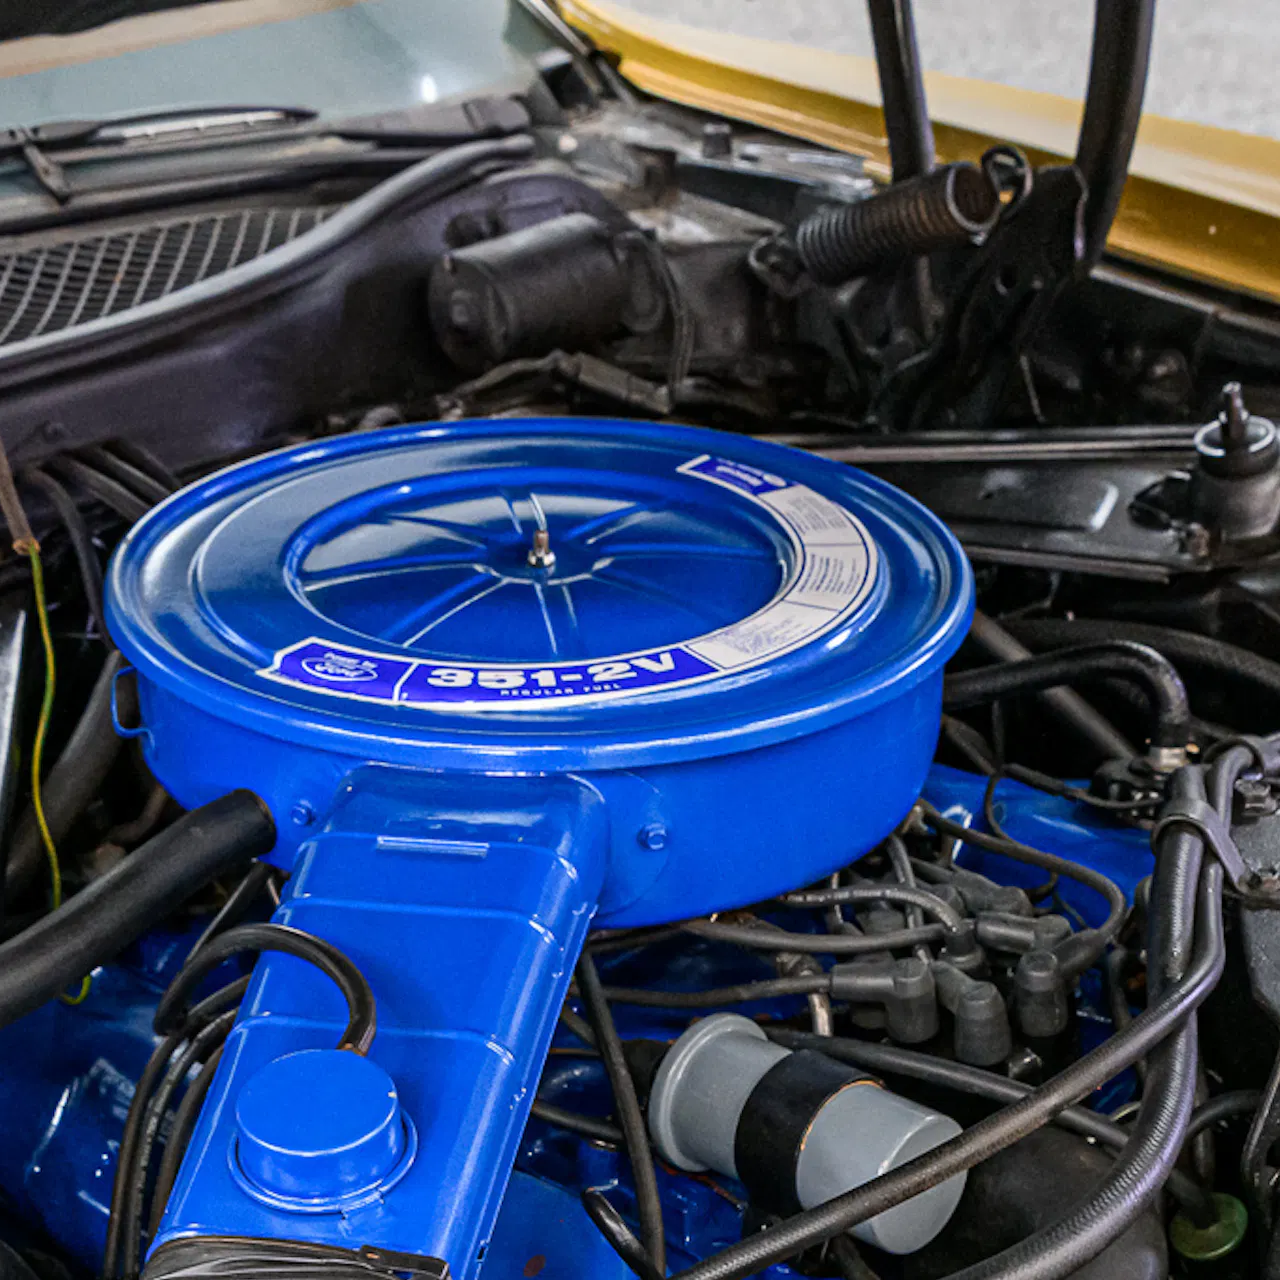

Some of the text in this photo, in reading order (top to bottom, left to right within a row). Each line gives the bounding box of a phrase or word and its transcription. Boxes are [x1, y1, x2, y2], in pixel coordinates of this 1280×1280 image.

[427, 652, 676, 689] 351-2V
[499, 682, 622, 697] REGULAR FUEL
